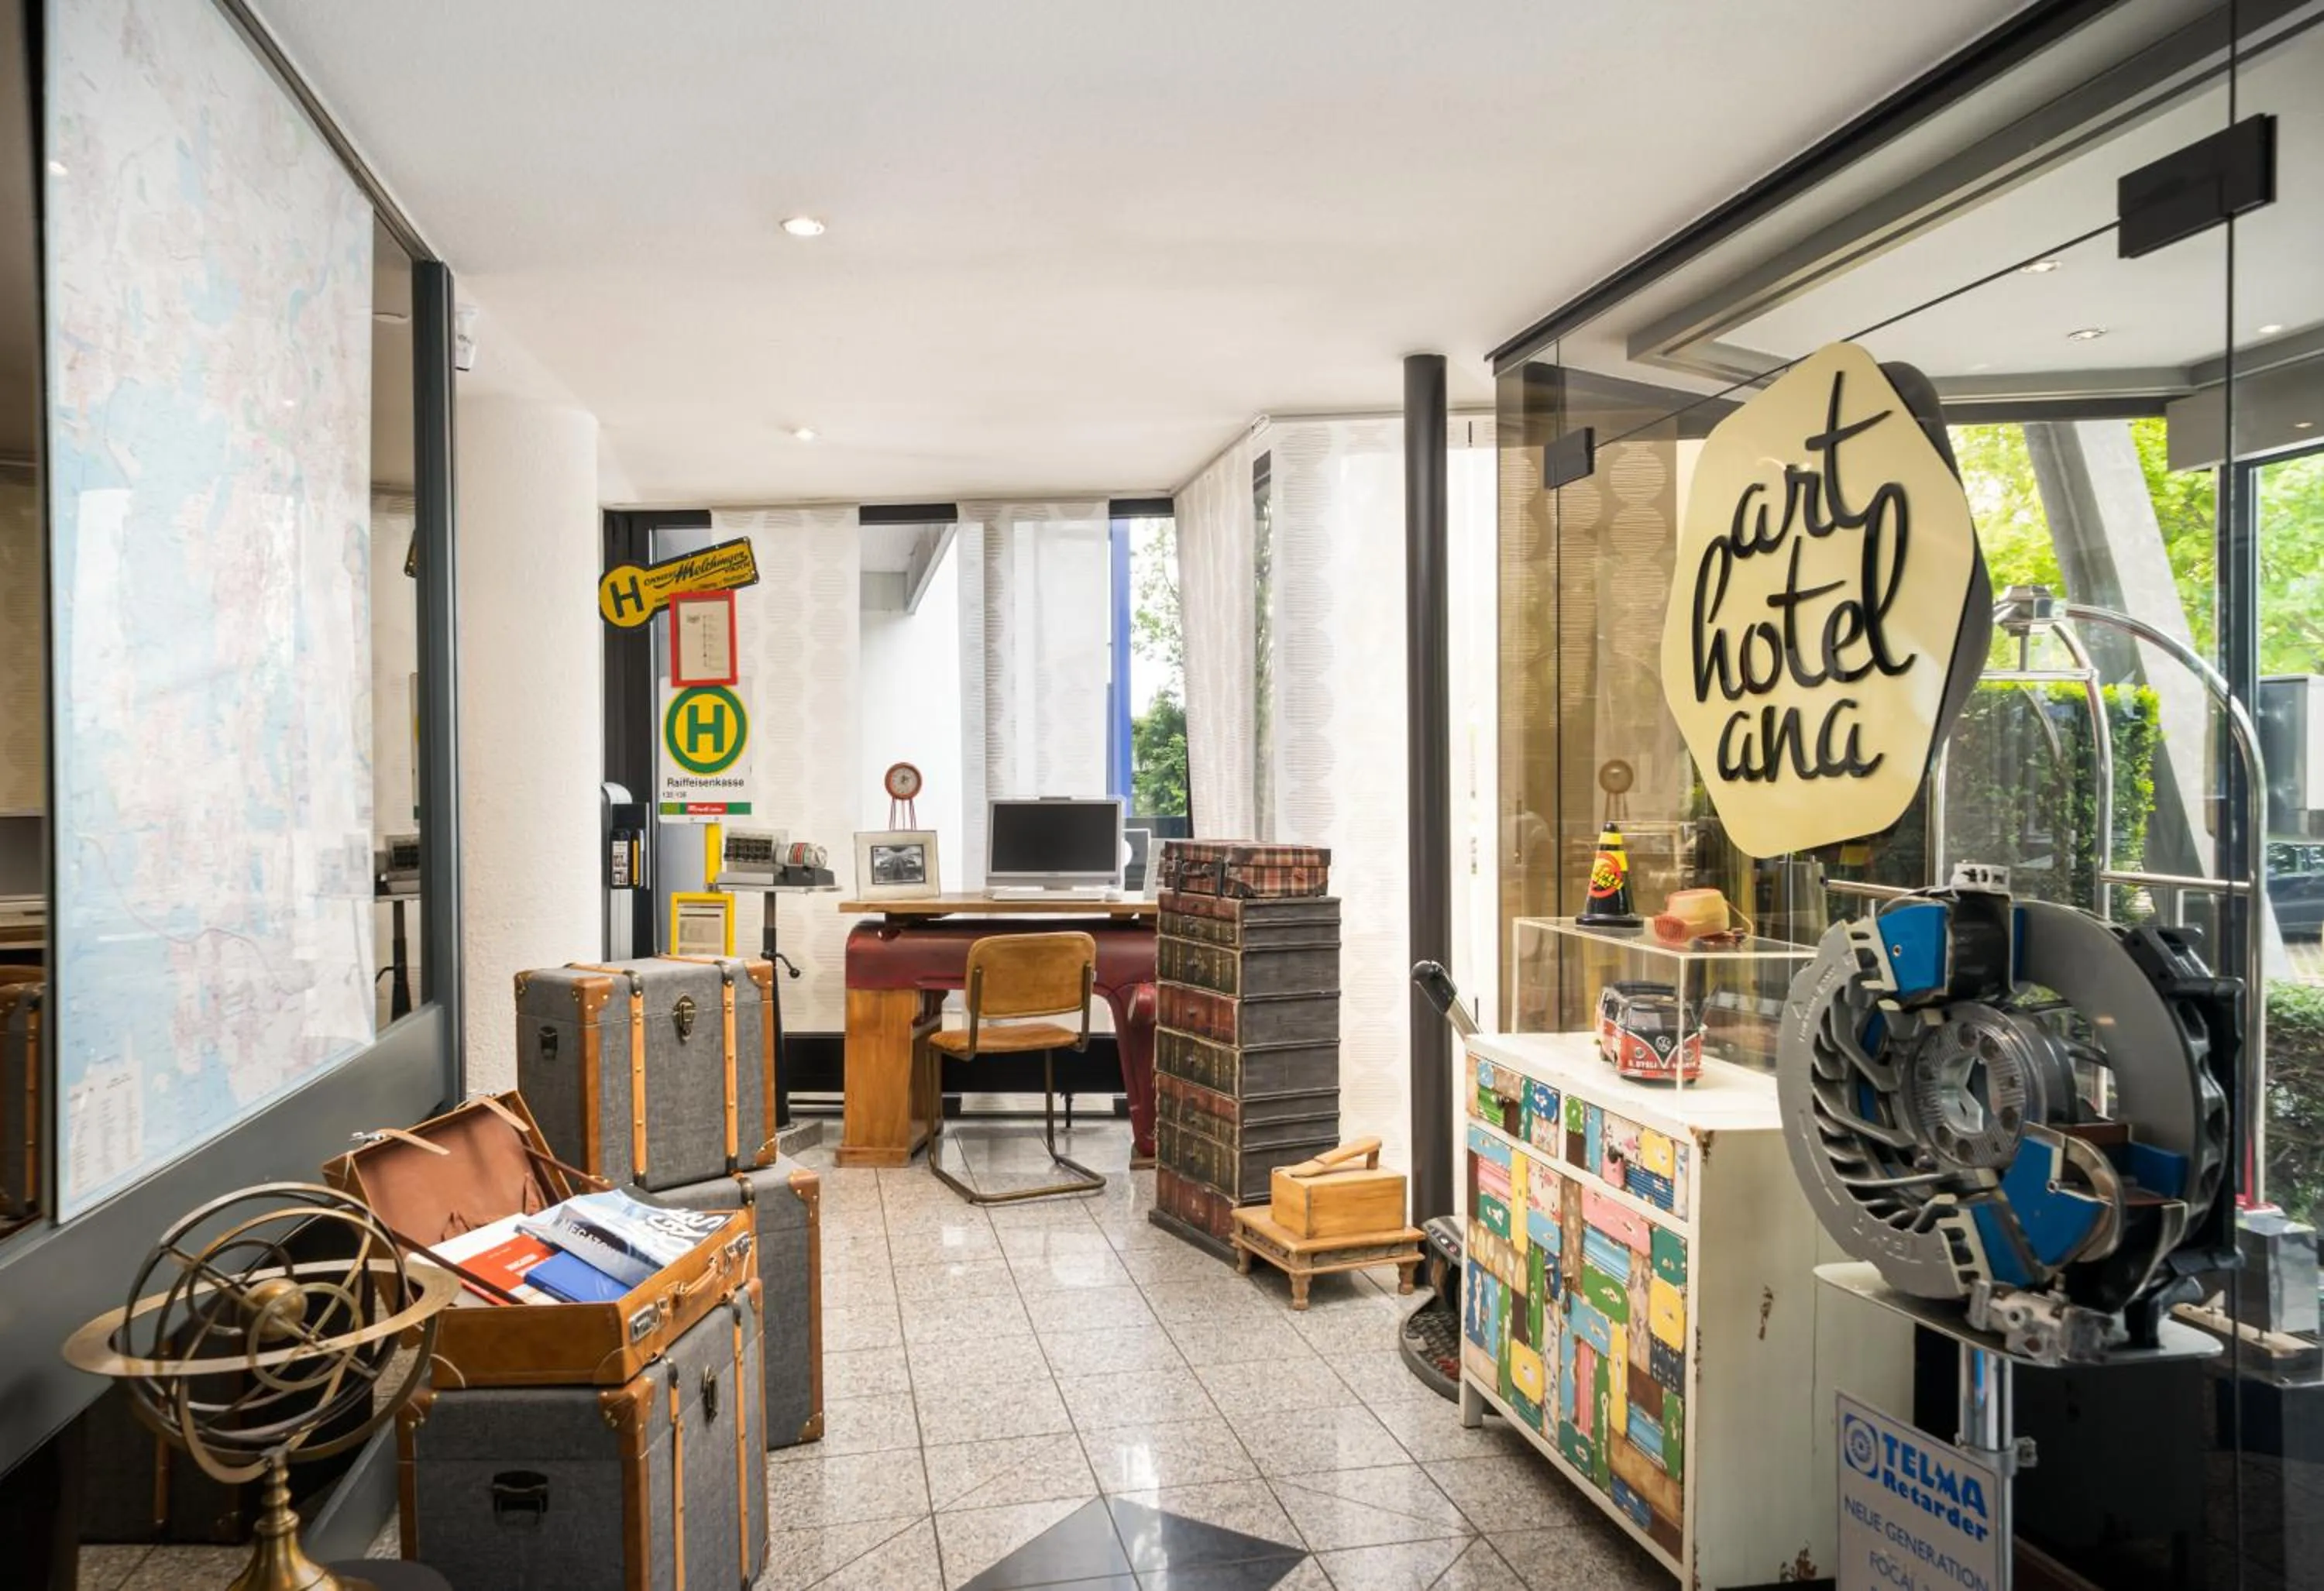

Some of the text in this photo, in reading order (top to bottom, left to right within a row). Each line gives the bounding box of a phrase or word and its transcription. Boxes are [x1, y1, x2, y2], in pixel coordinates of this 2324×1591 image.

[1731, 370, 1893, 559] art
[610, 575, 645, 618] H
[1692, 482, 1917, 704] hotel
[687, 704, 725, 753] H
[1717, 699, 1886, 783] ana
[667, 777, 744, 788] Raiffeisenkasse
[1882, 1431, 1988, 1520] TELMA
[1882, 1468, 1989, 1543] Retarder
[1844, 1495, 1989, 1591] NEUE GENERATION
